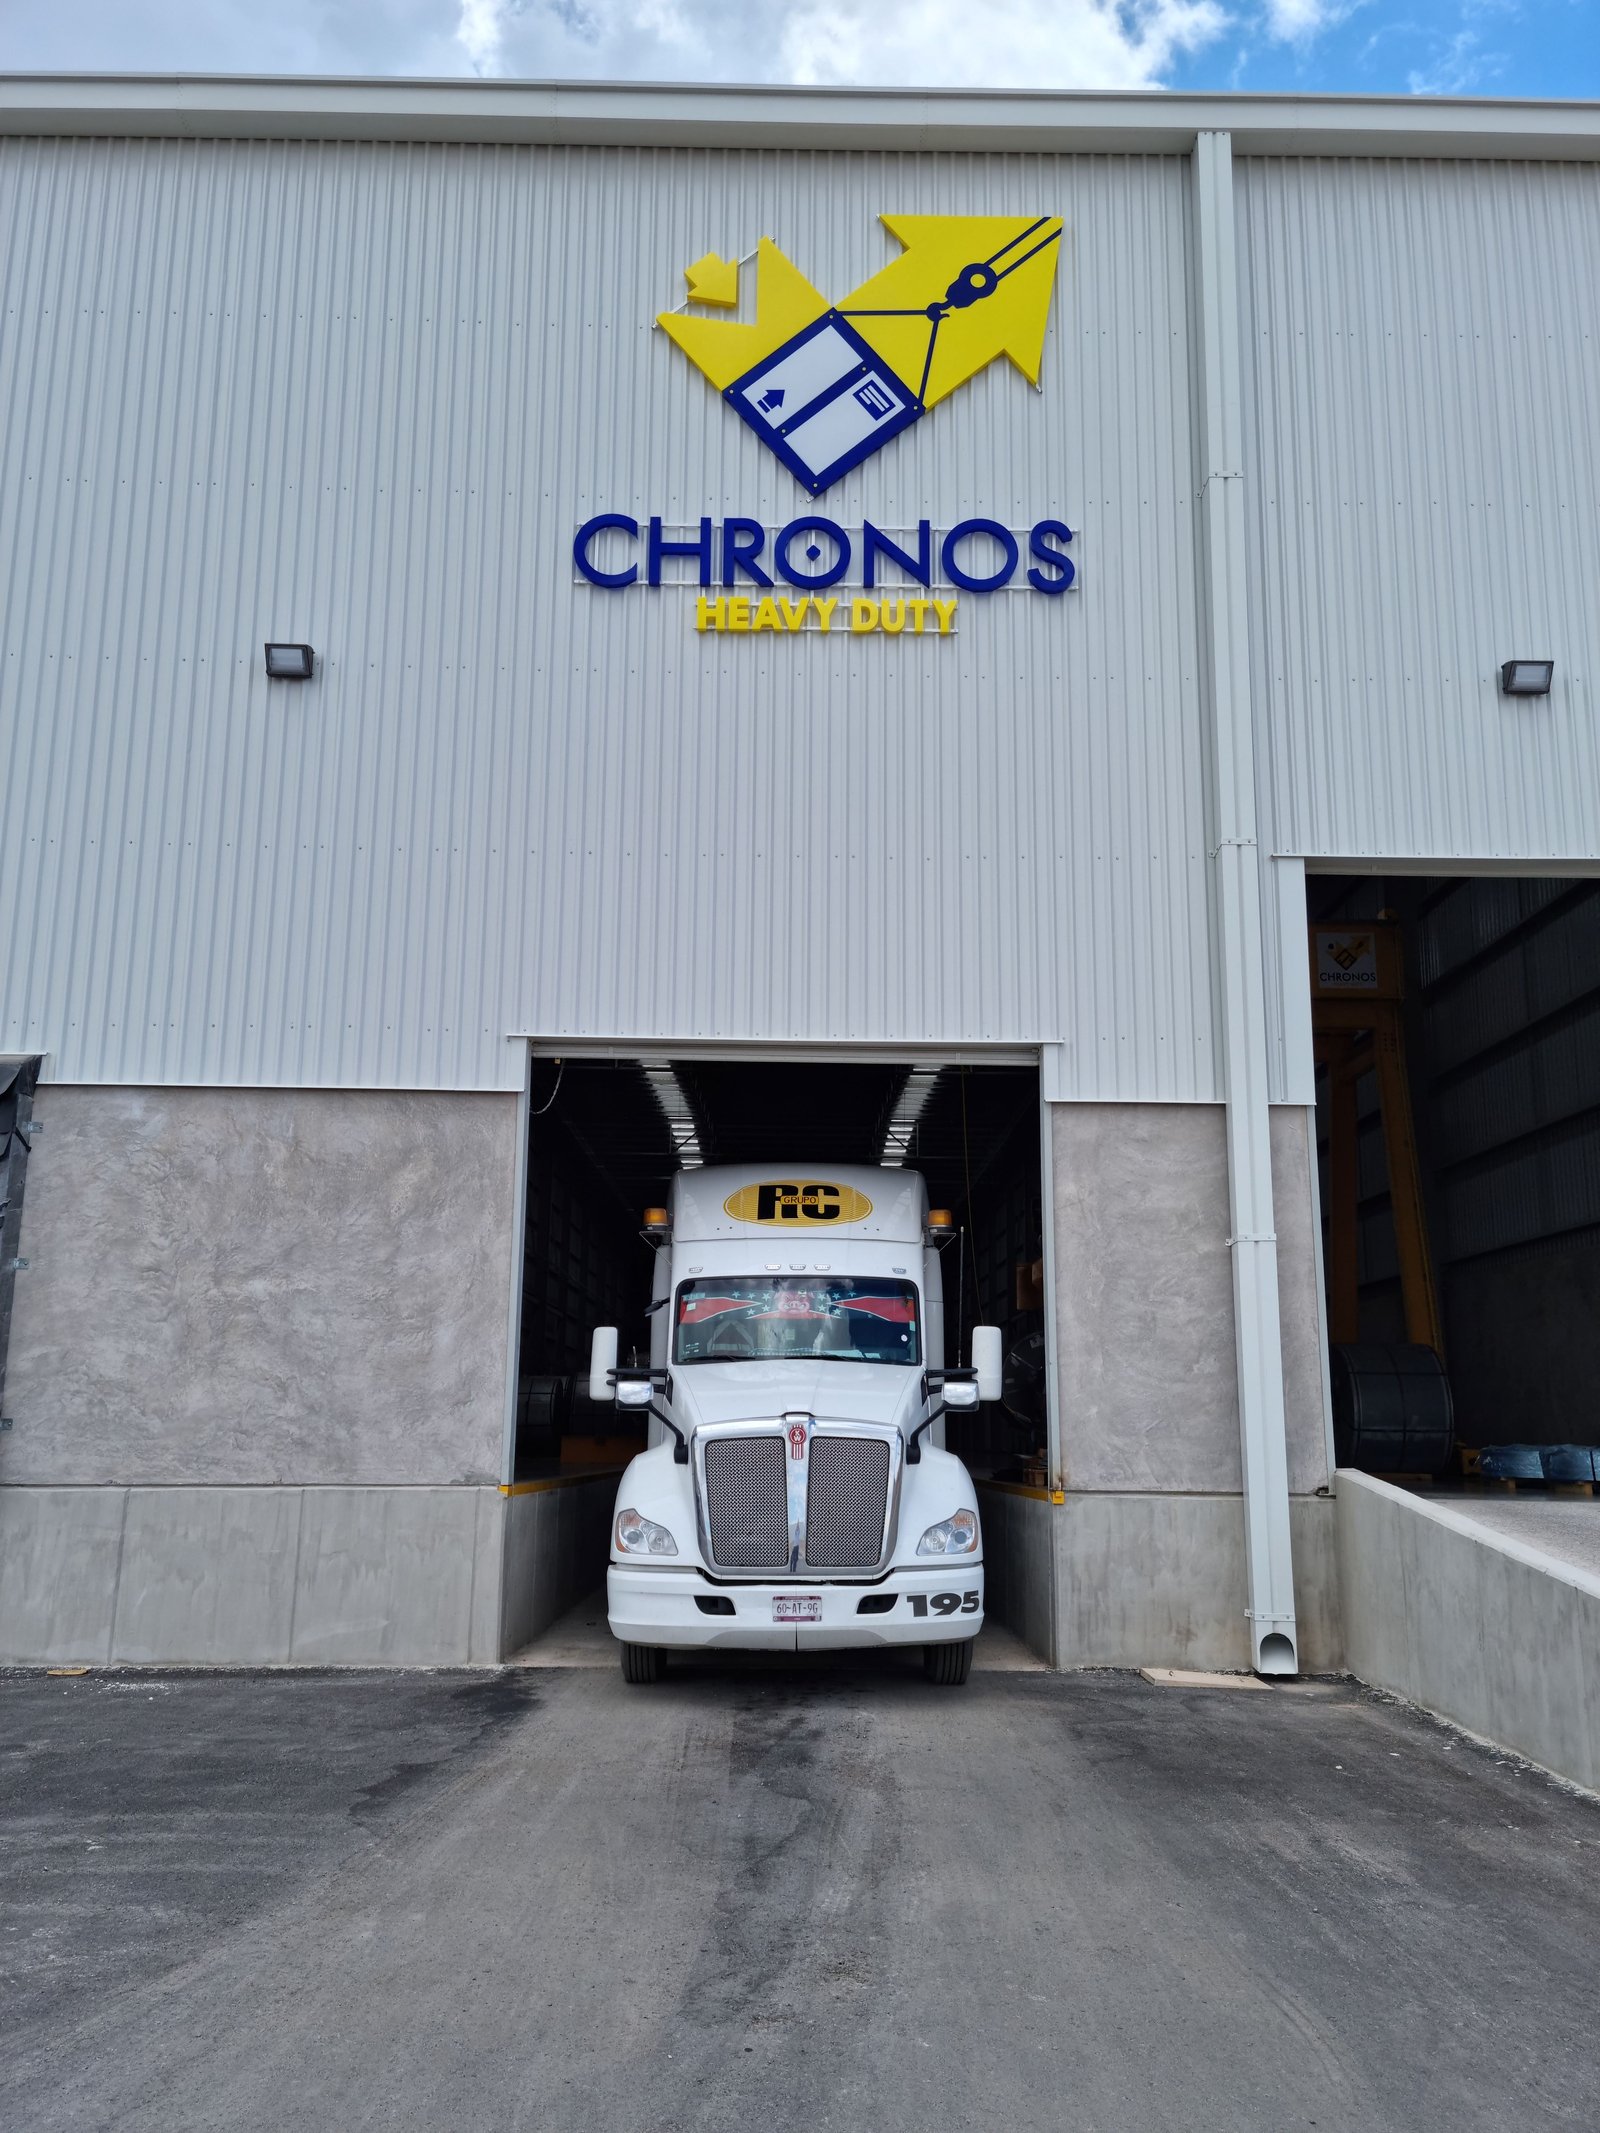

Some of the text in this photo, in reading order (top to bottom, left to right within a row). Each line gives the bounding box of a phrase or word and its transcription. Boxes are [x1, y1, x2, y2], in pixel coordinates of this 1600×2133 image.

[573, 513, 1076, 594] CHRONOS
[696, 597, 958, 635] HEAVY DUTY
[1319, 972, 1377, 982] CHRONOS
[757, 1185, 840, 1220] RC
[783, 1196, 817, 1204] GRUPO
[906, 1590, 980, 1617] 195
